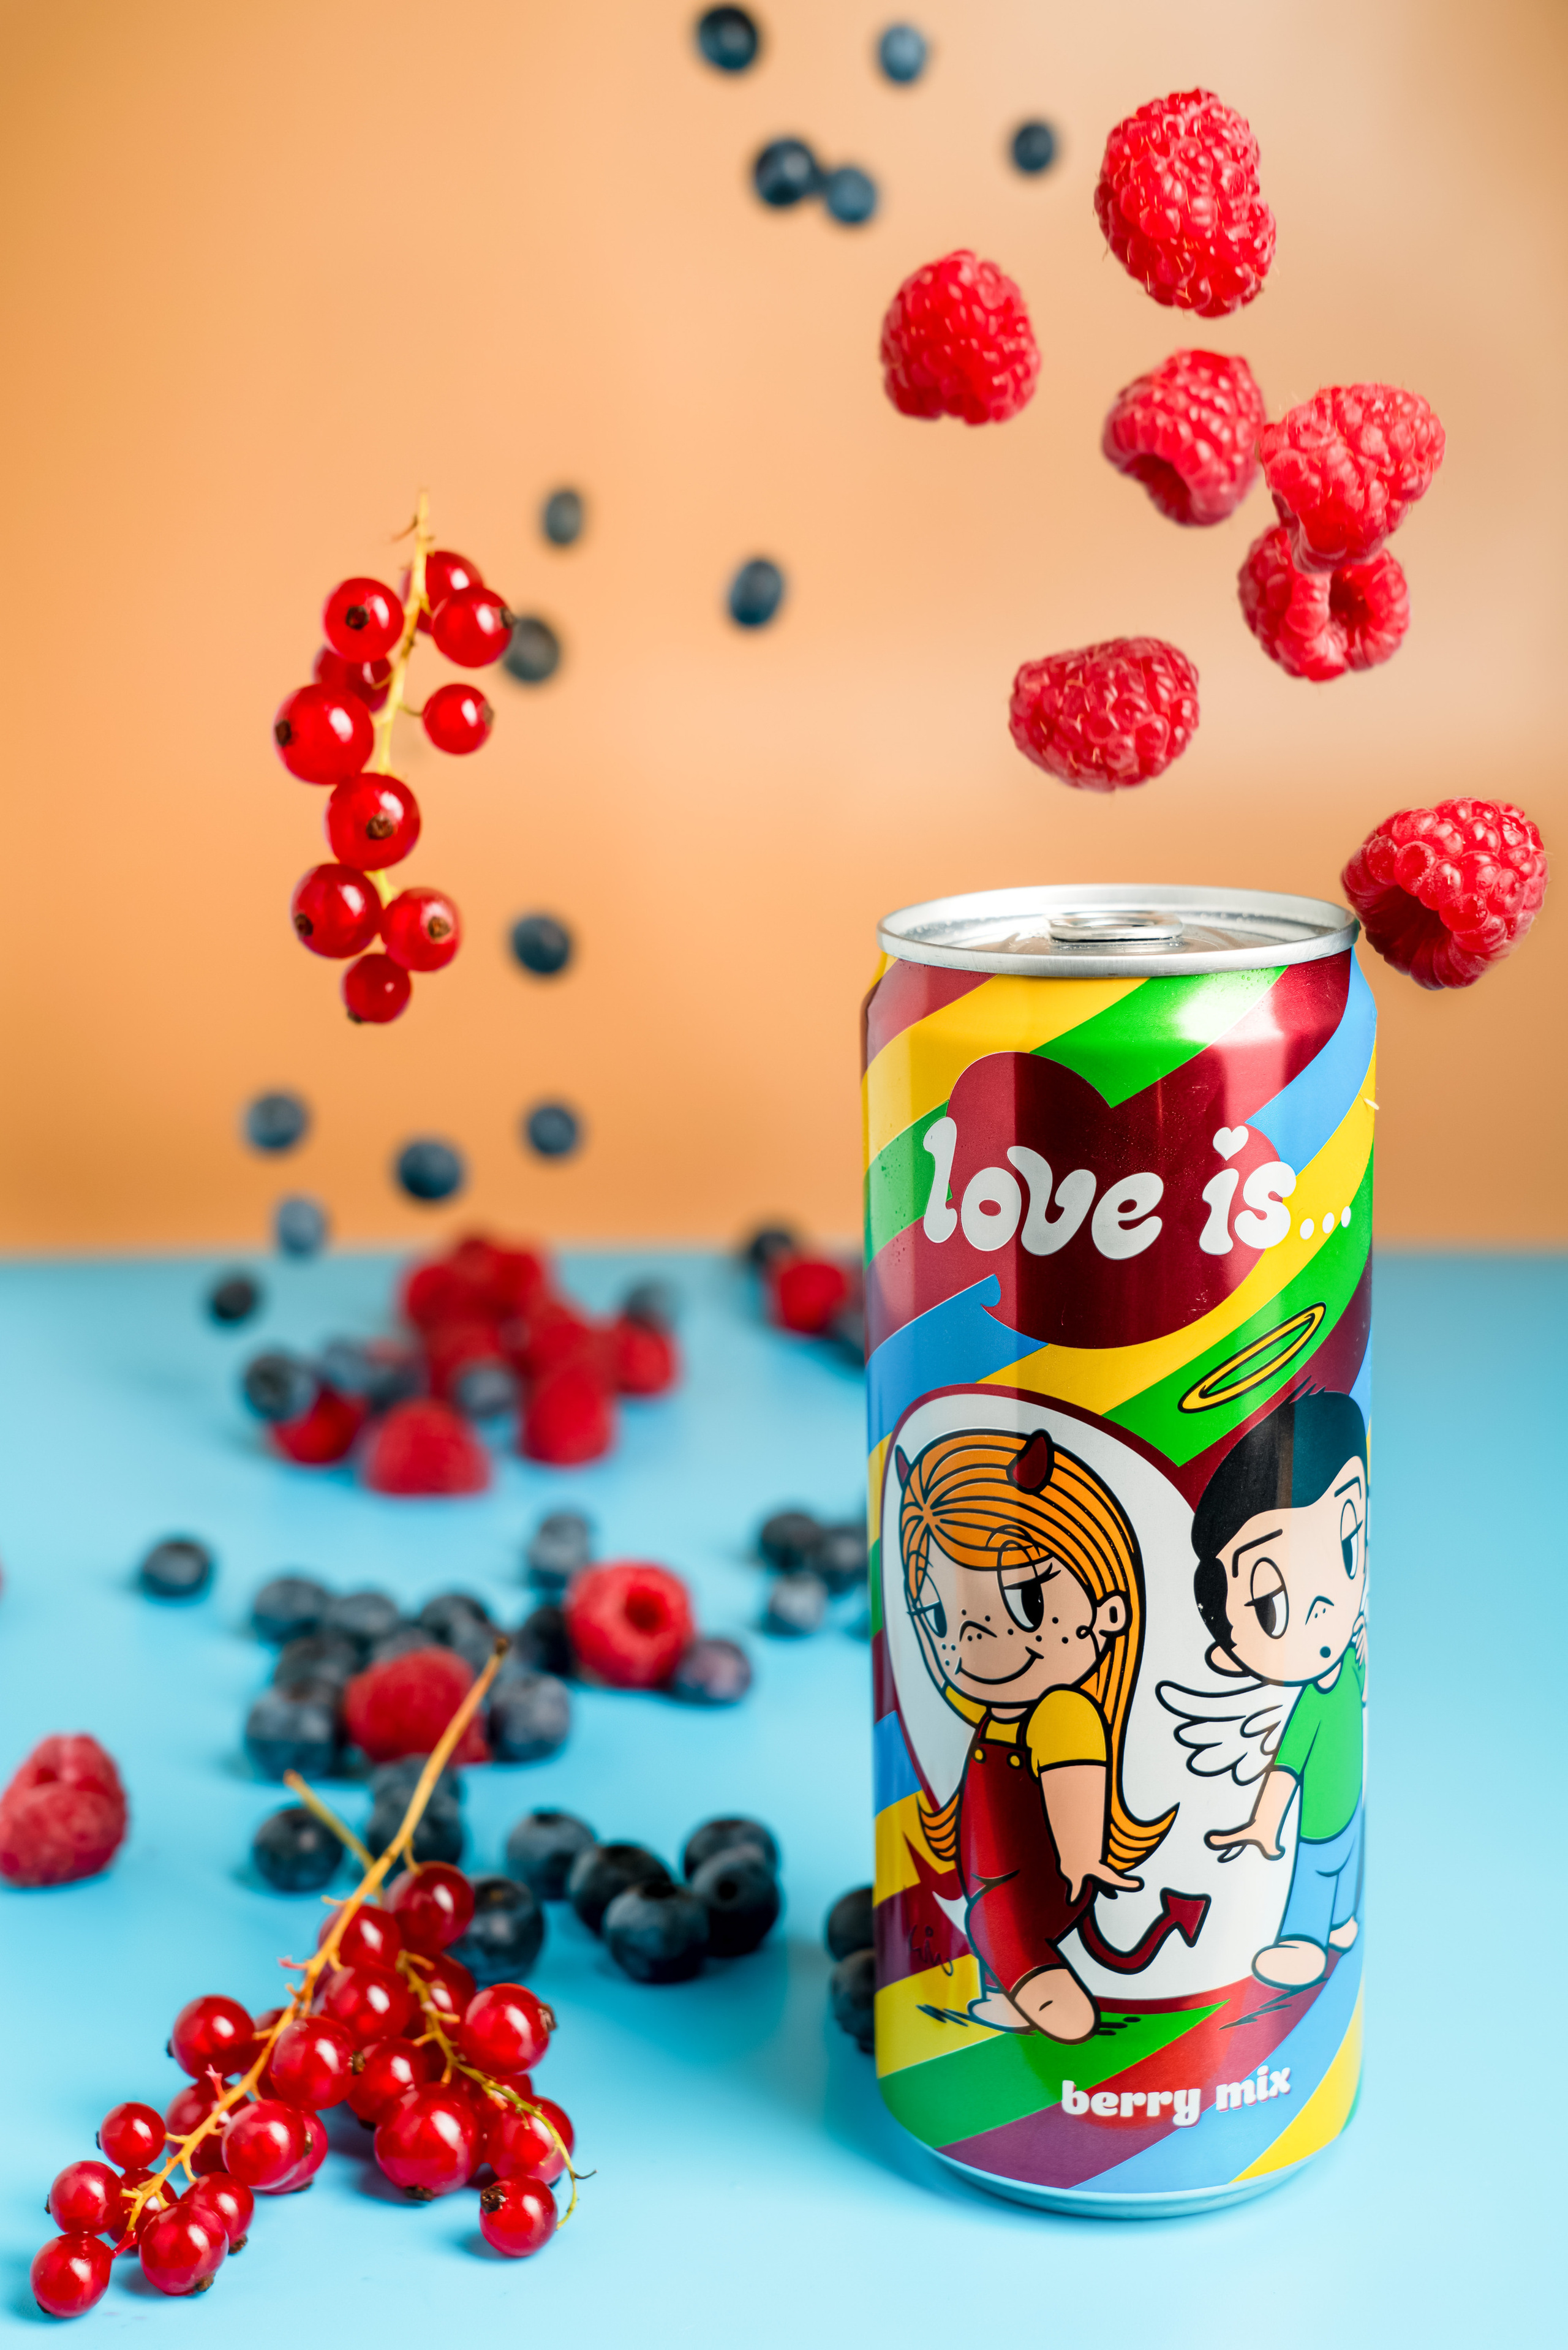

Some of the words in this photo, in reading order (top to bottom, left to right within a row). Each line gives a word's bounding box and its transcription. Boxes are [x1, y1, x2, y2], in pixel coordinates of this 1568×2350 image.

[922, 1117, 1164, 1260] love
[1199, 1126, 1352, 1255] is...
[1061, 2080, 1201, 2127] berry
[1216, 2065, 1291, 2112] mix
